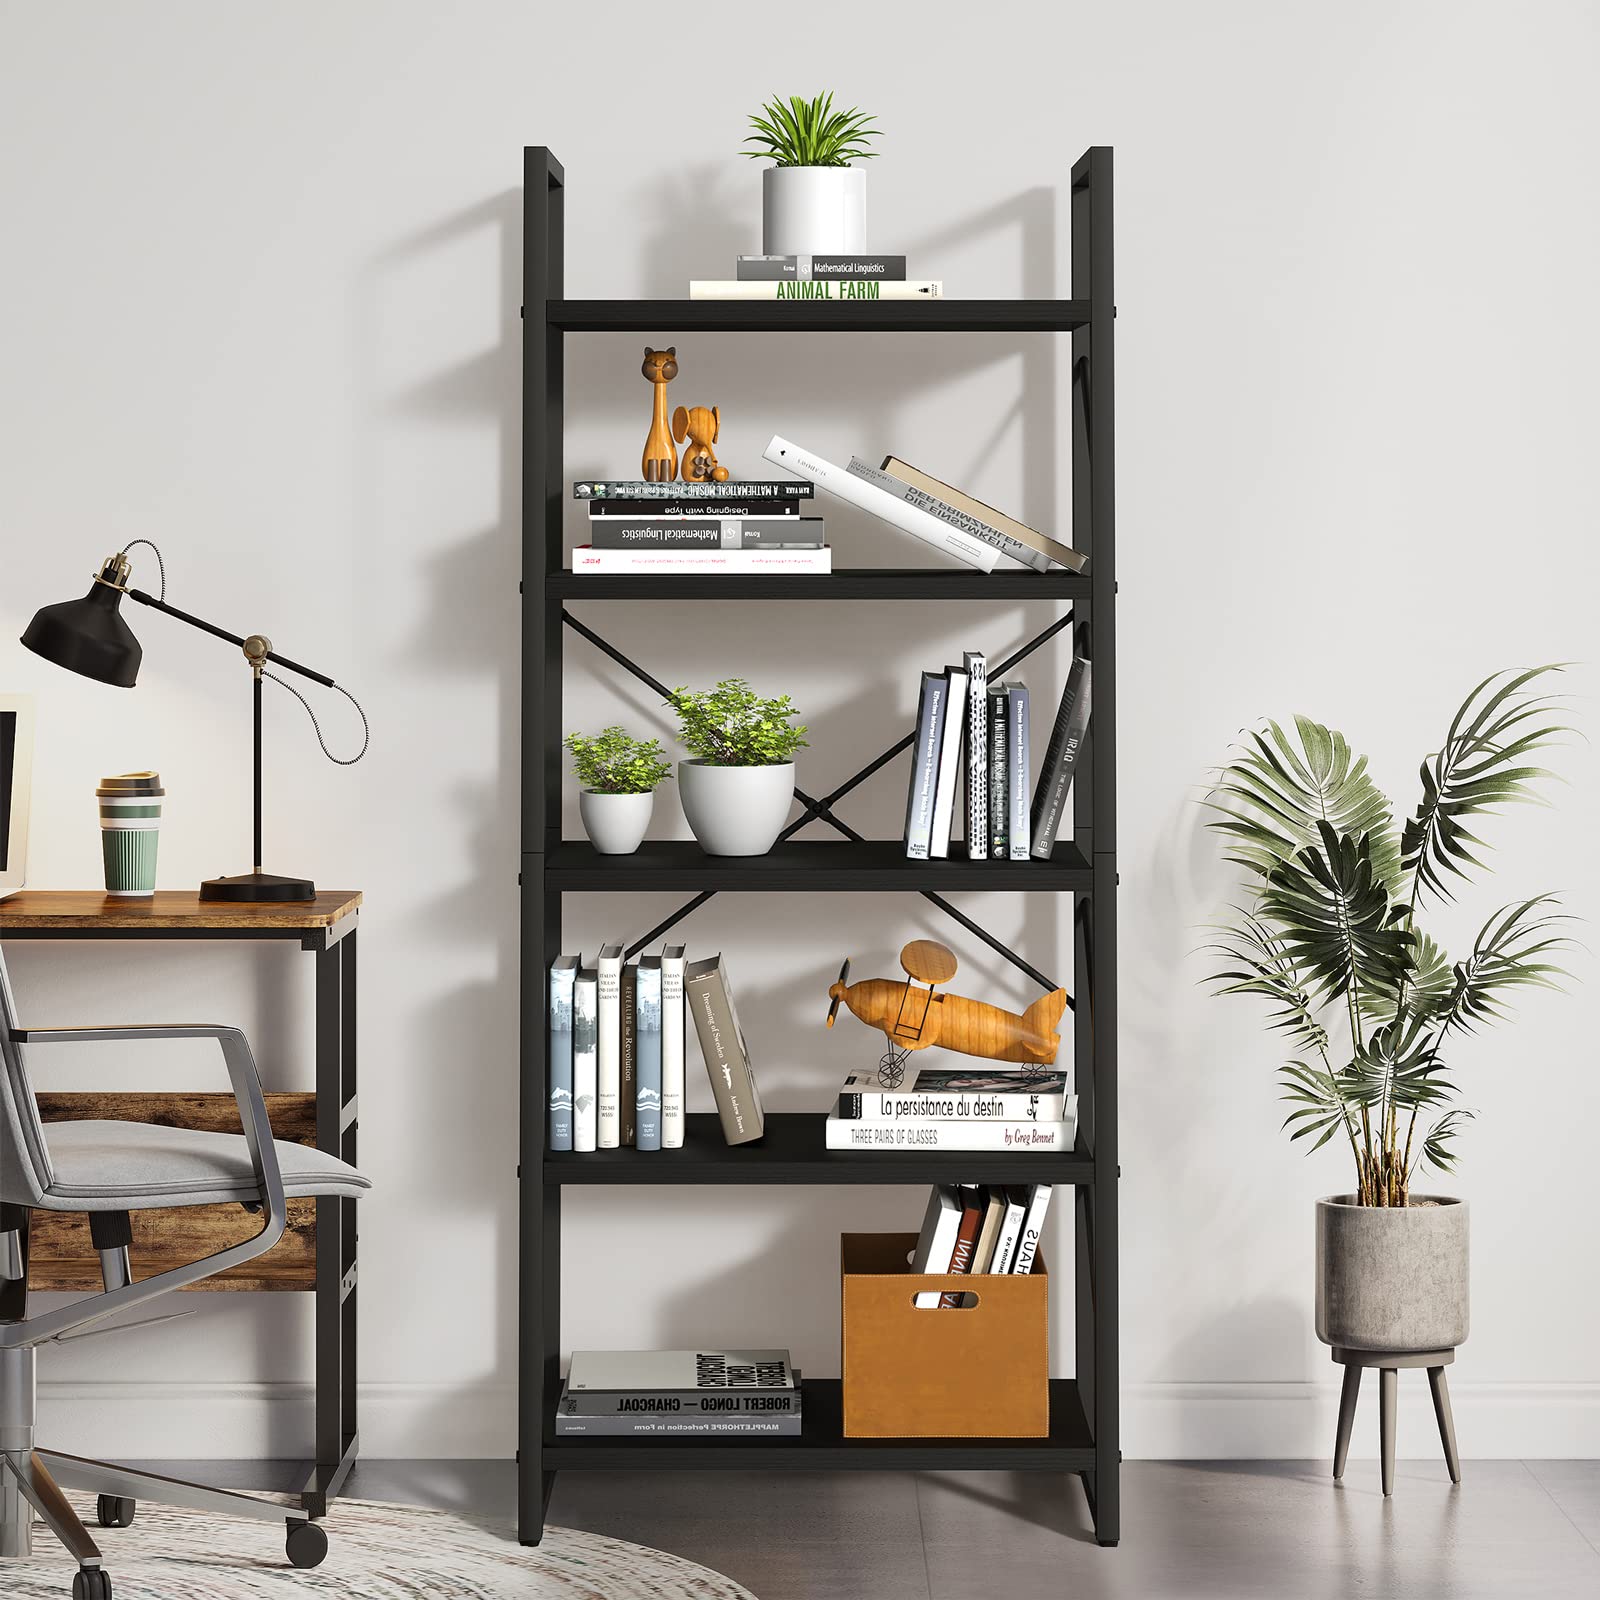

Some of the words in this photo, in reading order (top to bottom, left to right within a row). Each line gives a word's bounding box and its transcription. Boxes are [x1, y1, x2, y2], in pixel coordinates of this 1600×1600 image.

[814, 263, 853, 272] Mathematical
[854, 263, 885, 275] Linguistics
[776, 281, 832, 299] ANIMAL
[840, 281, 880, 299] FARM
[688, 486, 716, 495] MOSAIC
[716, 486, 772, 495] MATHEMATICAL
[773, 486, 778, 495] A
[664, 506, 684, 516] Type
[685, 506, 706, 515] with
[707, 506, 749, 516] Designing
[621, 528, 664, 541] Linguistics
[665, 529, 718, 541] Mathematical
[1062, 737, 1078, 762] IRAQ
[625, 986, 633, 1025] REVEALING
[702, 992, 714, 1025] Dreaming
[713, 1031, 724, 1058] Sweden
[625, 1037, 633, 1081] Revolution
[881, 1094, 893, 1115] La
[895, 1095, 954, 1119] persistance
[957, 1095, 970, 1115] du
[973, 1095, 1004, 1117] destin
[730, 1095, 738, 1117] Andrew
[735, 1114, 744, 1133] Brown
[851, 1129, 873, 1144] THREE
[874, 1129, 894, 1144] PAIRS
[896, 1129, 906, 1144] OF
[907, 1129, 938, 1145] GLASSES
[1004, 1129, 1014, 1146] by
[1014, 1129, 1031, 1145] Greg
[1031, 1129, 1055, 1144] Bennet
